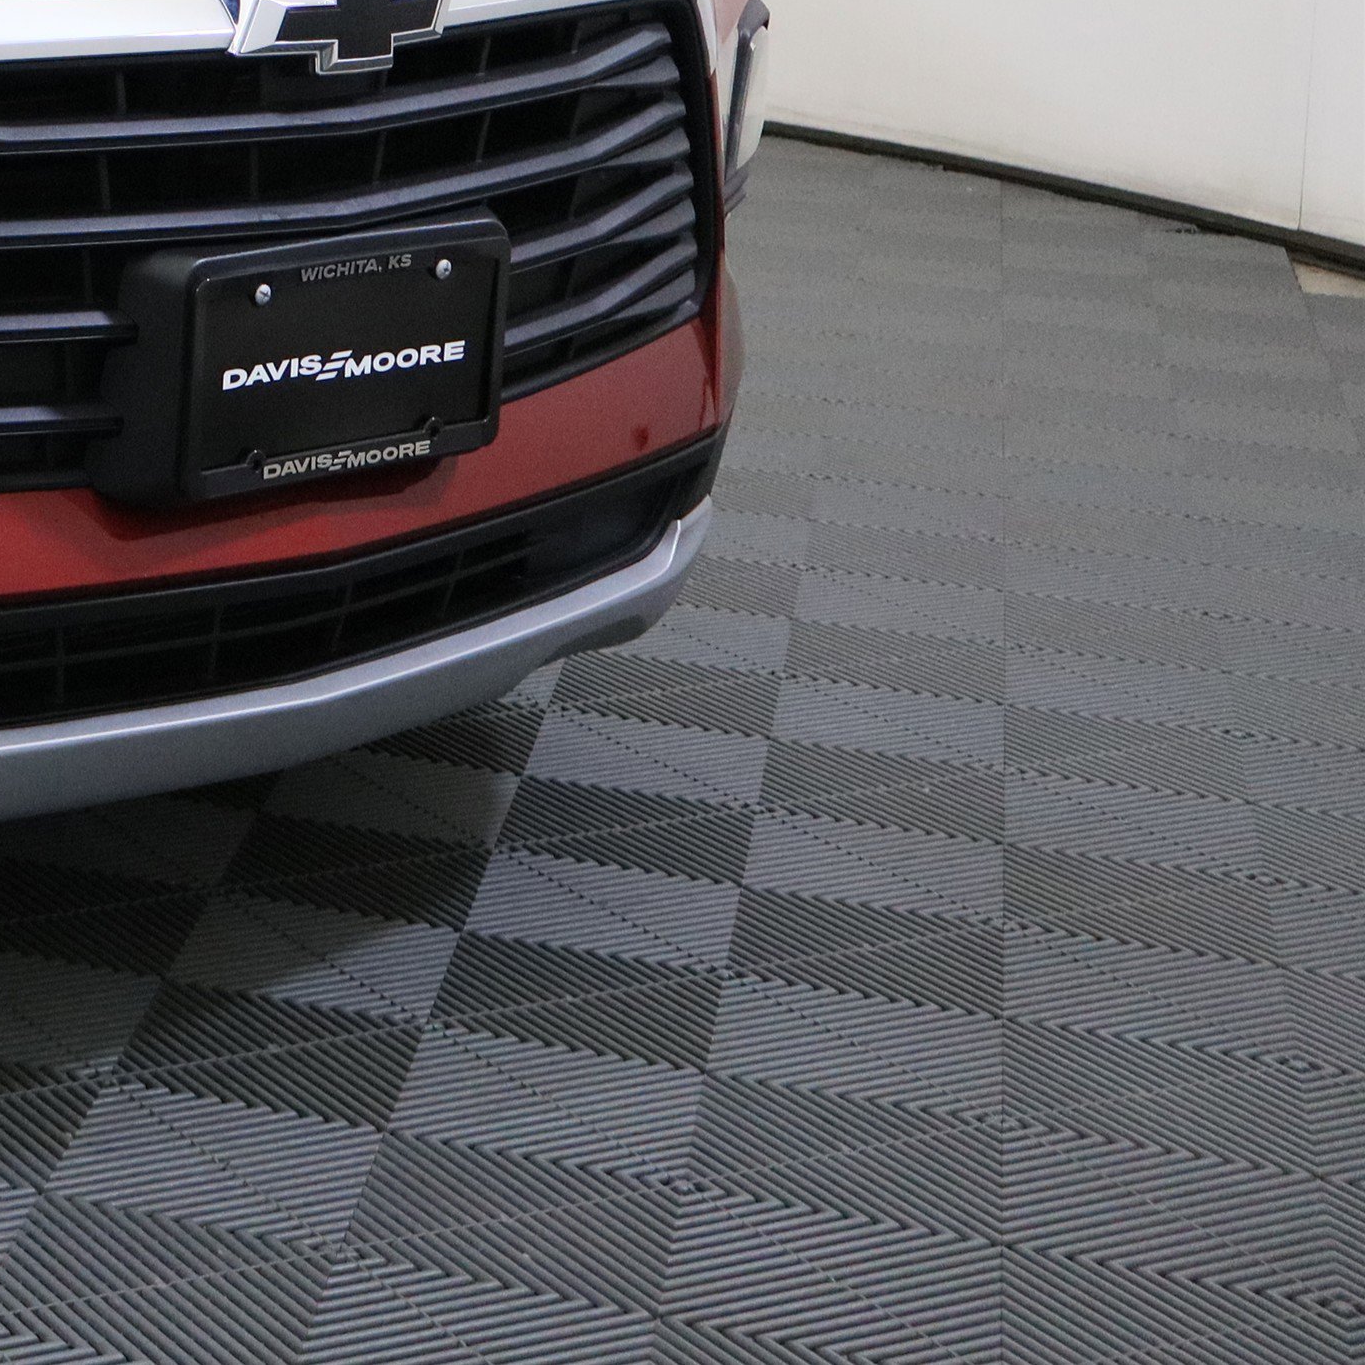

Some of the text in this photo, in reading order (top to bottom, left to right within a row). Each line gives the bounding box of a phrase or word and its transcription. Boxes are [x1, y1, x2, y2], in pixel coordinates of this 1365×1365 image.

[301, 253, 413, 283] WICHITA, KS
[222, 340, 466, 391] DAVIS MOORE
[263, 439, 431, 480] DAVIS MOORE
